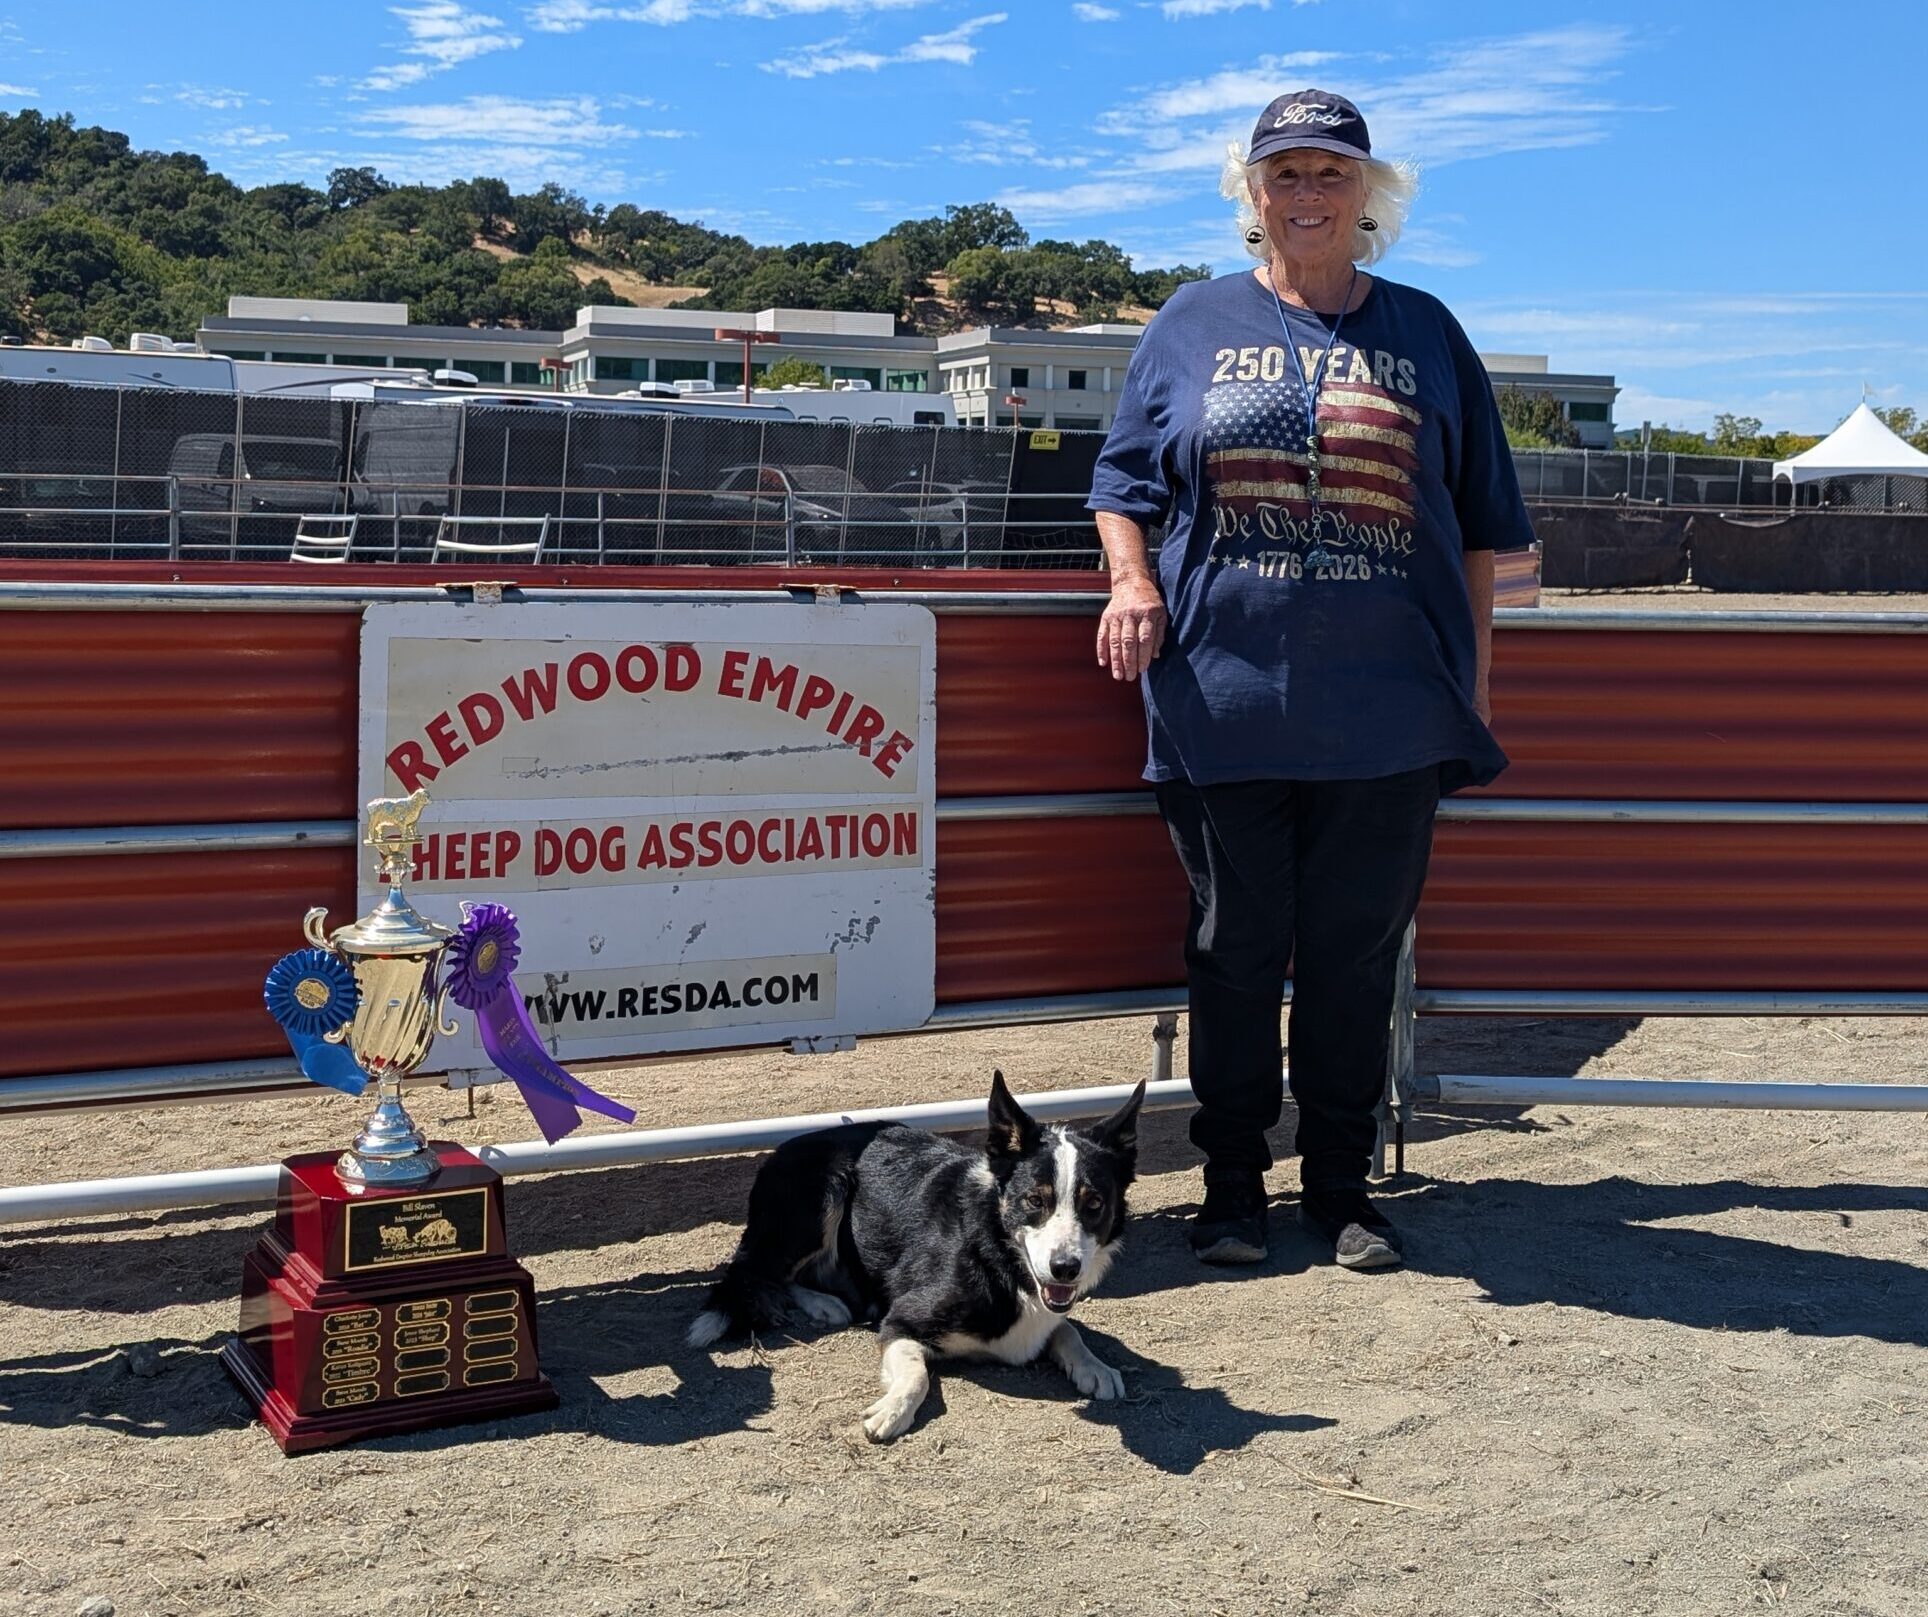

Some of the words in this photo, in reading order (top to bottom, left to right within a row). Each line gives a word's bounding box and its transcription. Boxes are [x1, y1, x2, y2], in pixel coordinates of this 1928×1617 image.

[1273, 102, 1357, 128] Ford
[1212, 346, 1285, 384] 250
[1299, 346, 1417, 396] YEARS
[1033, 434, 1048, 445] EXIT
[1211, 502, 1255, 544] We
[1255, 501, 1315, 549] The
[1320, 509, 1416, 558] People
[1257, 551, 1303, 580] 1776
[386, 644, 702, 795] REDWOOD
[717, 650, 915, 780] EMPIRE
[379, 830, 521, 883] HEEP
[534, 824, 627, 877] DOG
[636, 811, 918, 871] ASSOCIATION
[525, 972, 819, 1024] WW.RESDA.COM
[423, 1210, 443, 1220] Award
